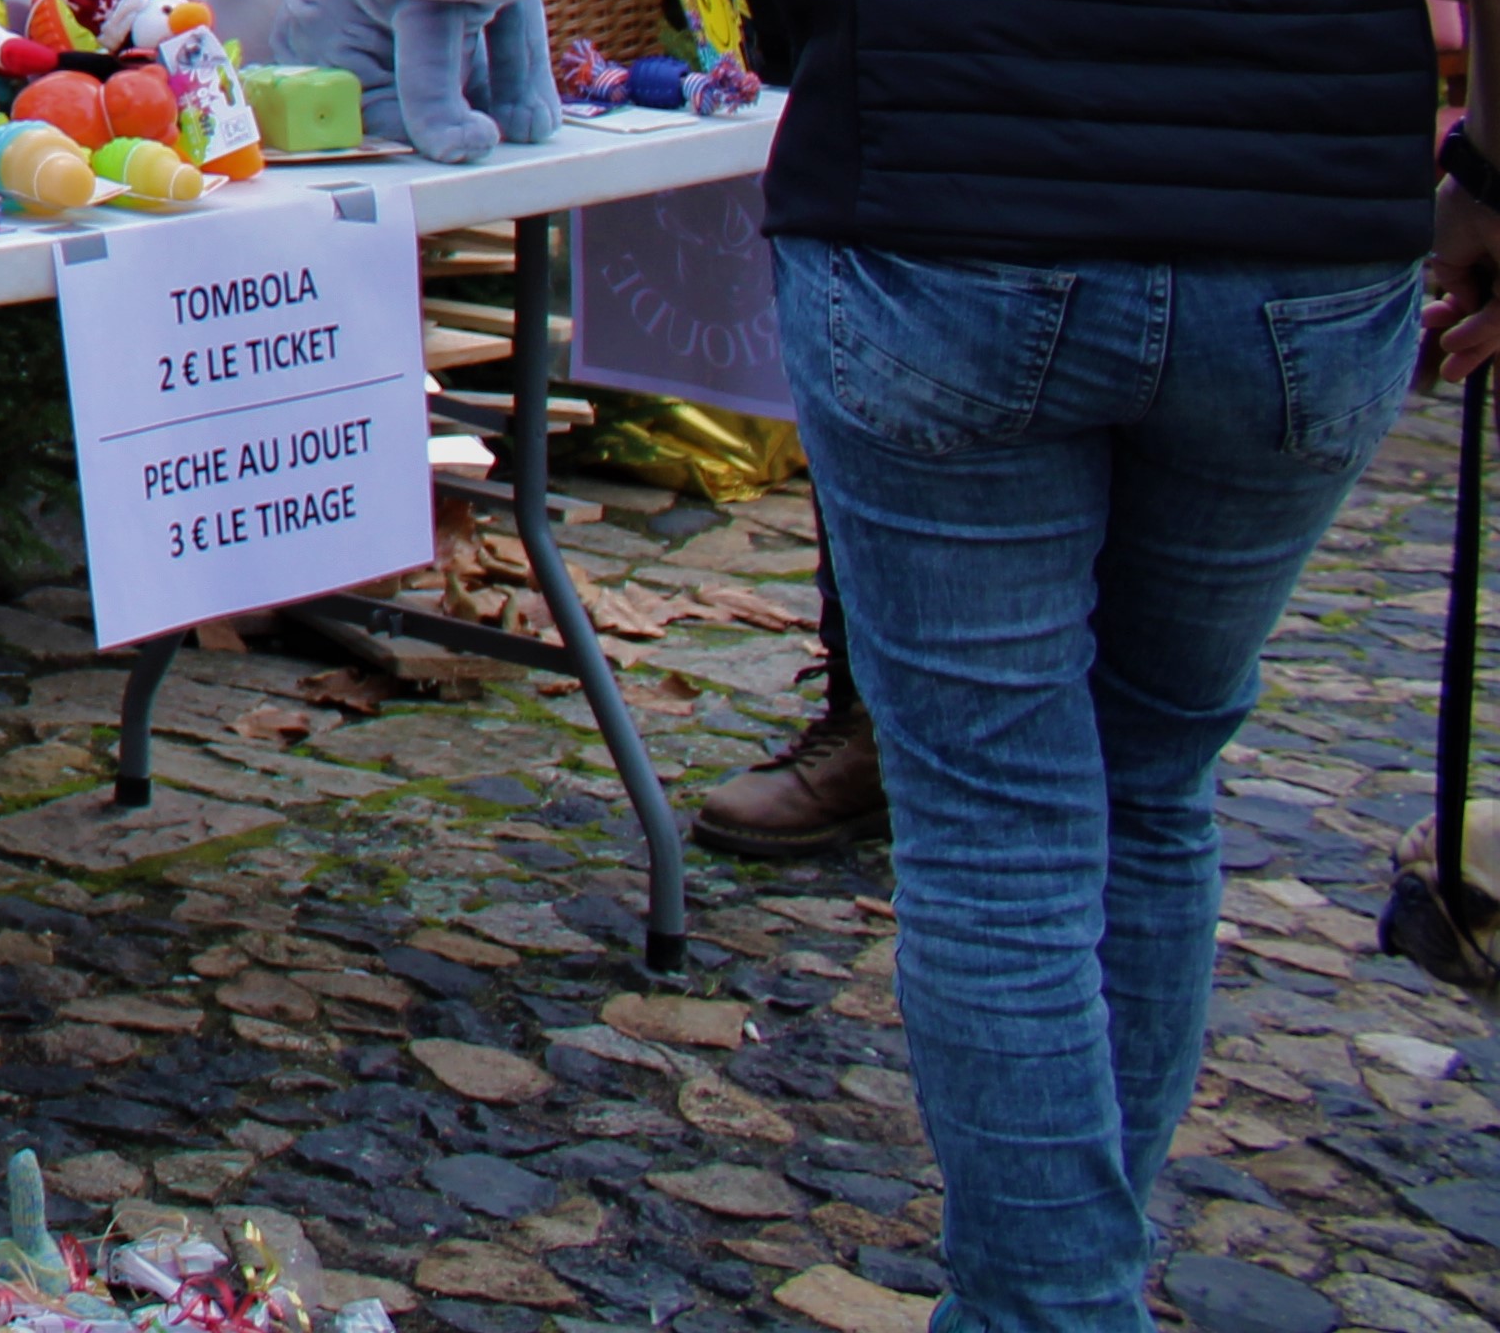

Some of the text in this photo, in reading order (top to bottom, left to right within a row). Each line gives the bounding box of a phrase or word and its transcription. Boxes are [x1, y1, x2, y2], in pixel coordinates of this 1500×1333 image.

[169, 267, 318, 325] TOMBOLA
[158, 324, 339, 392] 2 € LE TICKET
[144, 418, 372, 500] PECHE AU JOUET
[169, 484, 356, 559] 3 € LE TIRAGE
